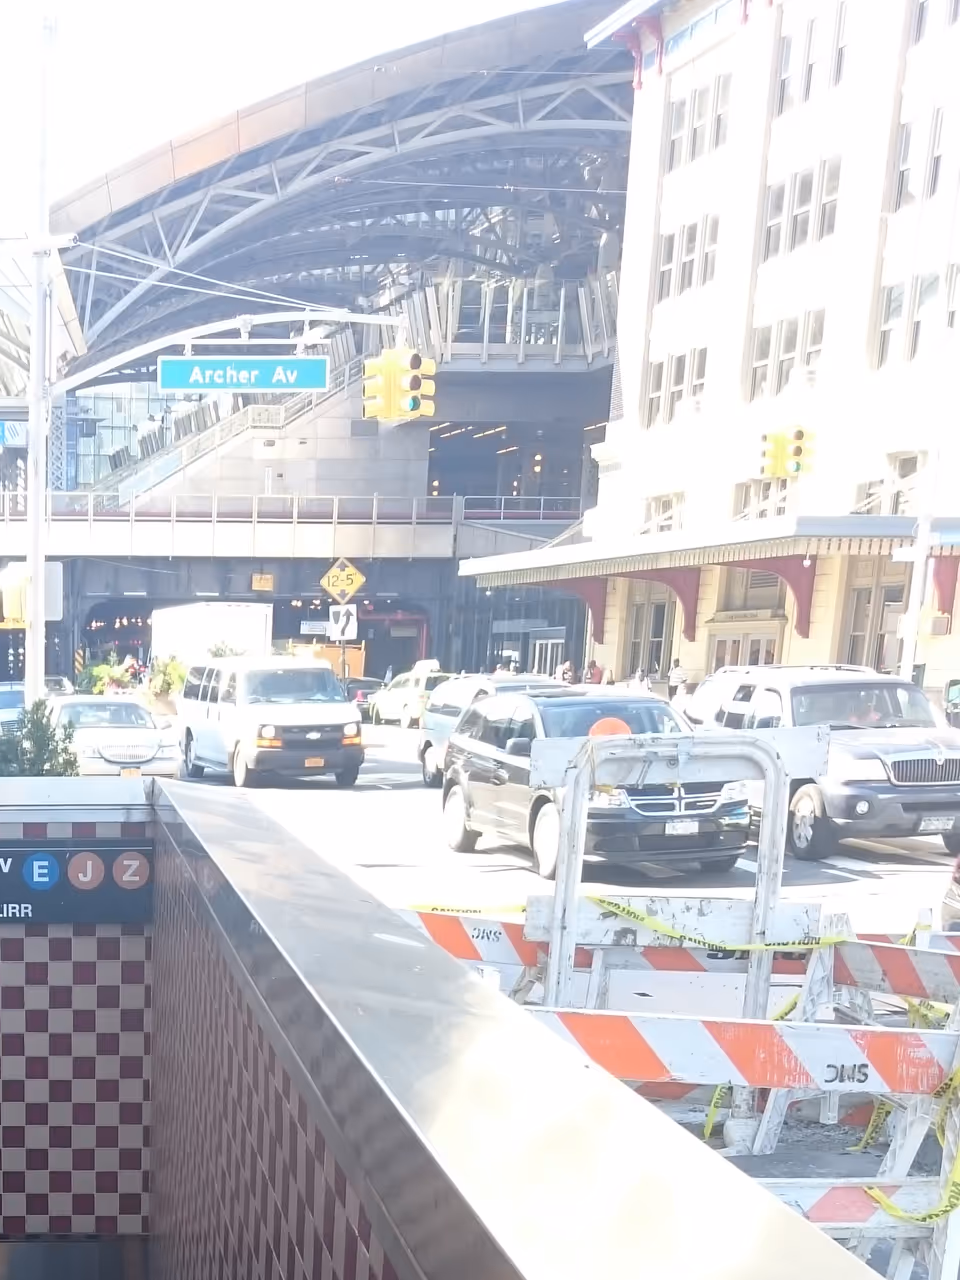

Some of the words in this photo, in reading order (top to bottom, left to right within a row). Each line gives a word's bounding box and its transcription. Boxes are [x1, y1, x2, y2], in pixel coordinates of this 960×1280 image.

[189, 366, 259, 384] Archer
[272, 366, 298, 384] Av
[32, 860, 50, 883] E
[77, 860, 93, 884] J
[122, 860, 140, 883] Z
